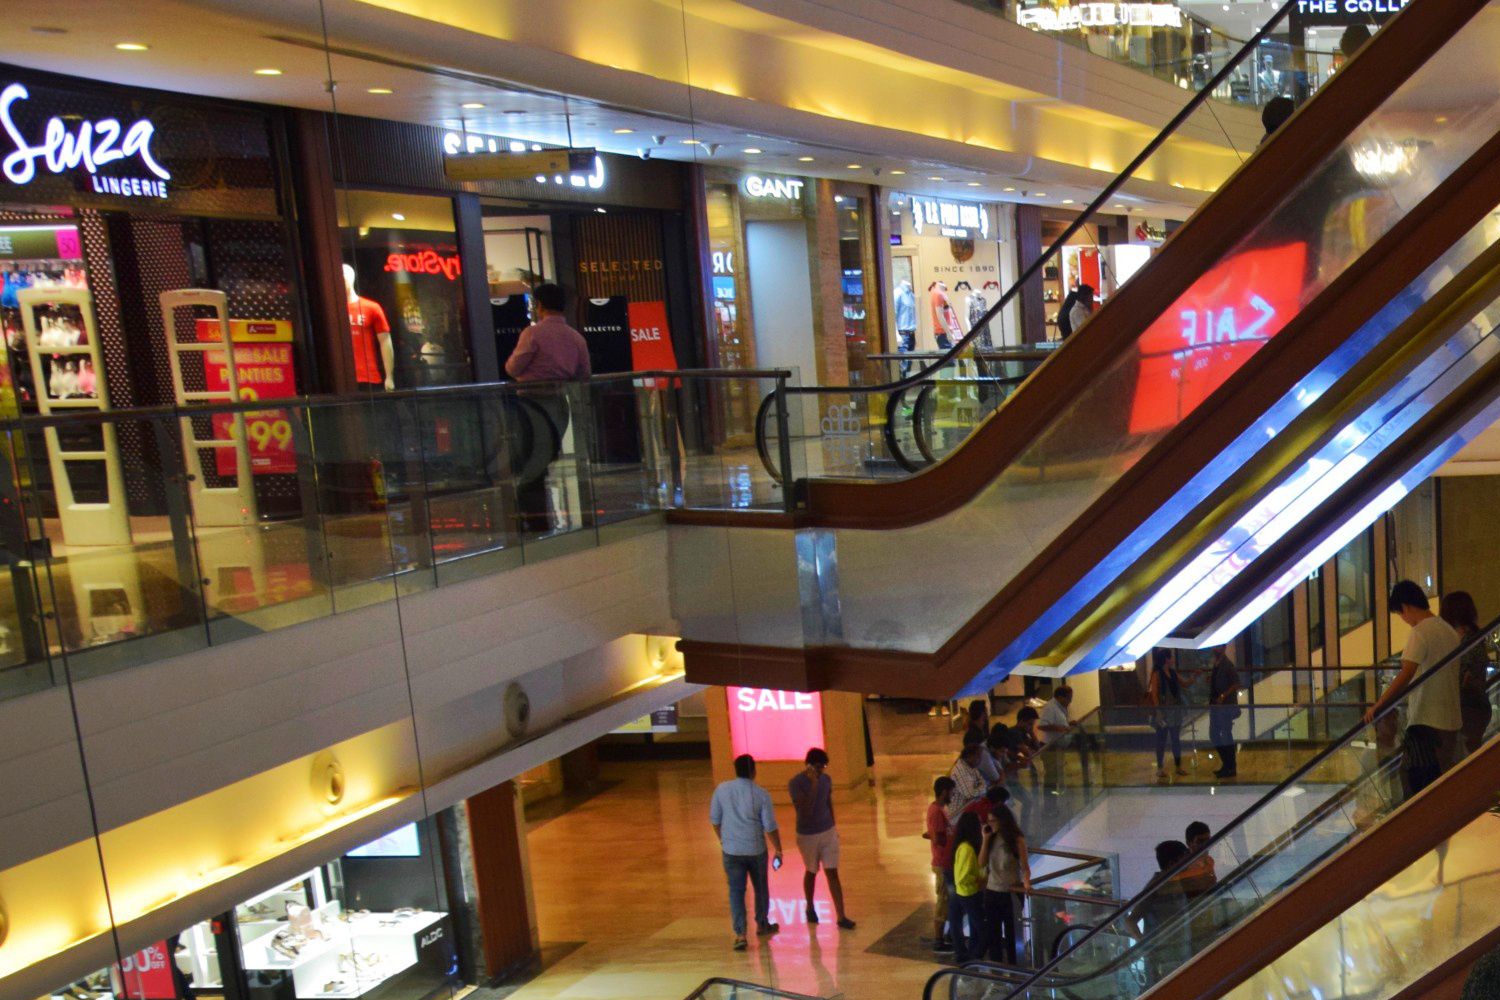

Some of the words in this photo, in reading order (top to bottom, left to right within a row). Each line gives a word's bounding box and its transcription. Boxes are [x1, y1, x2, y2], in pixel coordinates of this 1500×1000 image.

[1298, 0, 1337, 13] THE
[0, 84, 171, 184] Senza
[92, 175, 168, 198] LINGERIE
[746, 176, 804, 200] GANT
[579, 260, 663, 273] SELECTED
[630, 327, 661, 342] SALE
[253, 348, 290, 363] SALE
[219, 368, 285, 383] PNTIES
[737, 687, 813, 712] SALE
